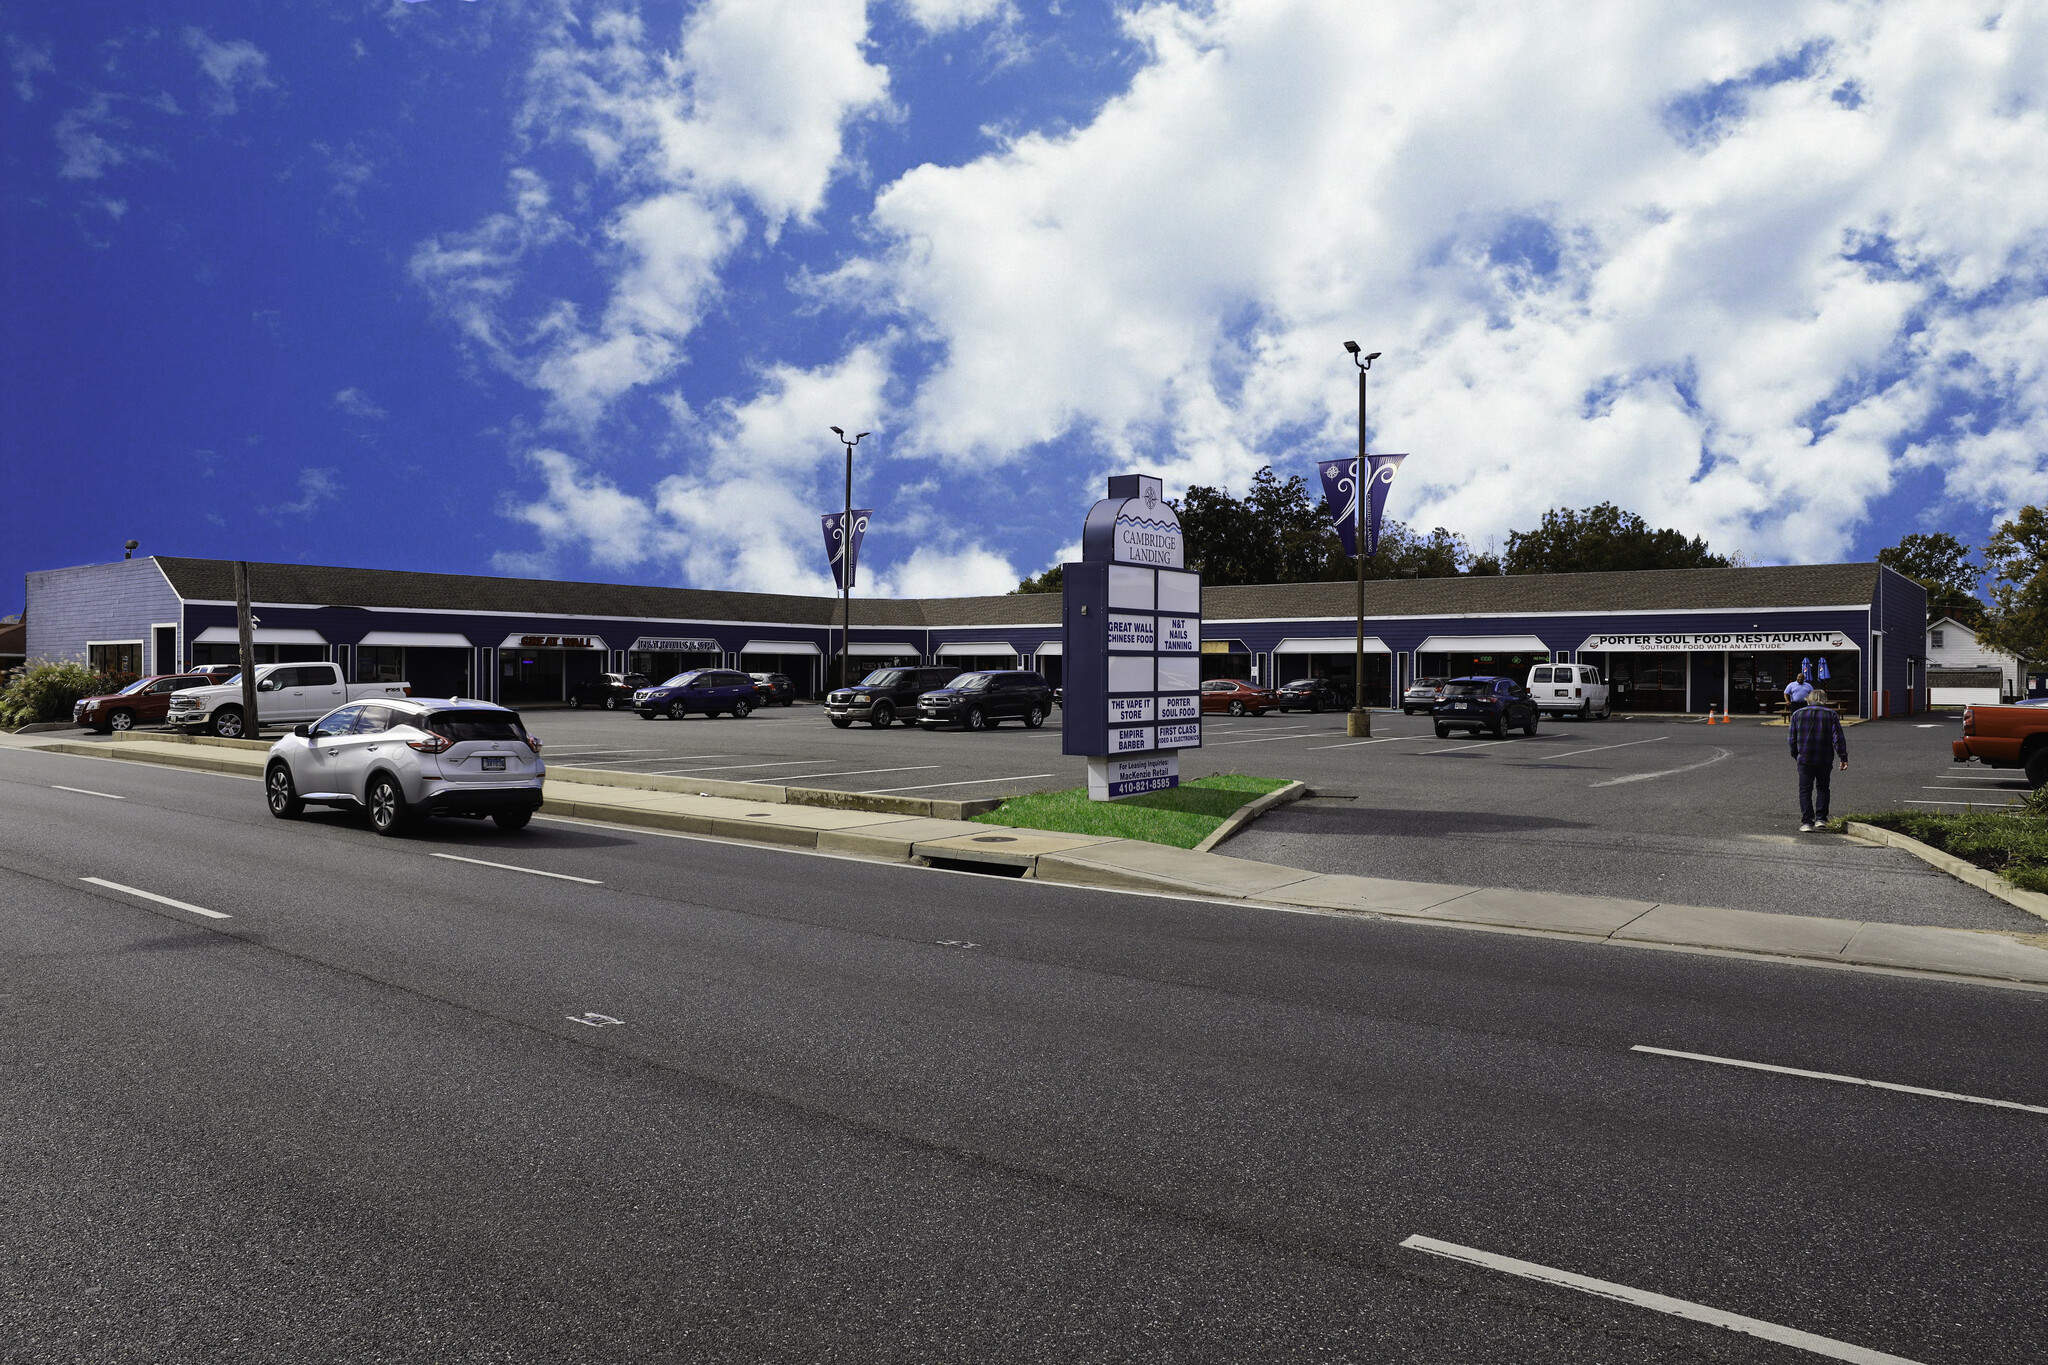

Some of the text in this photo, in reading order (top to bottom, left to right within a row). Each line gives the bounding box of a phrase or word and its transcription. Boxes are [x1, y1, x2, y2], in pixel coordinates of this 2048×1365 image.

[1123, 530, 1176, 550] CAMBRIDGE
[1129, 547, 1171, 564] LANDING
[1108, 622, 1153, 633] GREAT WALL
[1172, 620, 1185, 628] N&T
[1108, 634, 1153, 643] CHINESE FOOD
[1170, 631, 1188, 639] NAILS
[1600, 633, 1832, 644] PORTER SOUL FOOD RESTAURANT
[521, 636, 594, 647] GREAT WALL
[661, 640, 688, 650] NAILS
[698, 642, 716, 650] SPA
[1165, 641, 1192, 650] TANNING
[1112, 699, 1150, 709] THE VAPE IT
[1167, 698, 1190, 707] PORTER
[1120, 710, 1142, 720] STORE
[1162, 707, 1196, 718] SOUL FOOD
[1119, 729, 1144, 739] EMPIRE
[1159, 725, 1197, 736] FIRST CLASS
[1118, 740, 1145, 750] BARBER
[1128, 761, 1147, 769] Leasing
[1120, 768, 1169, 780] MacKenzie Retail
[1119, 778, 1170, 793] 410-821-8585
